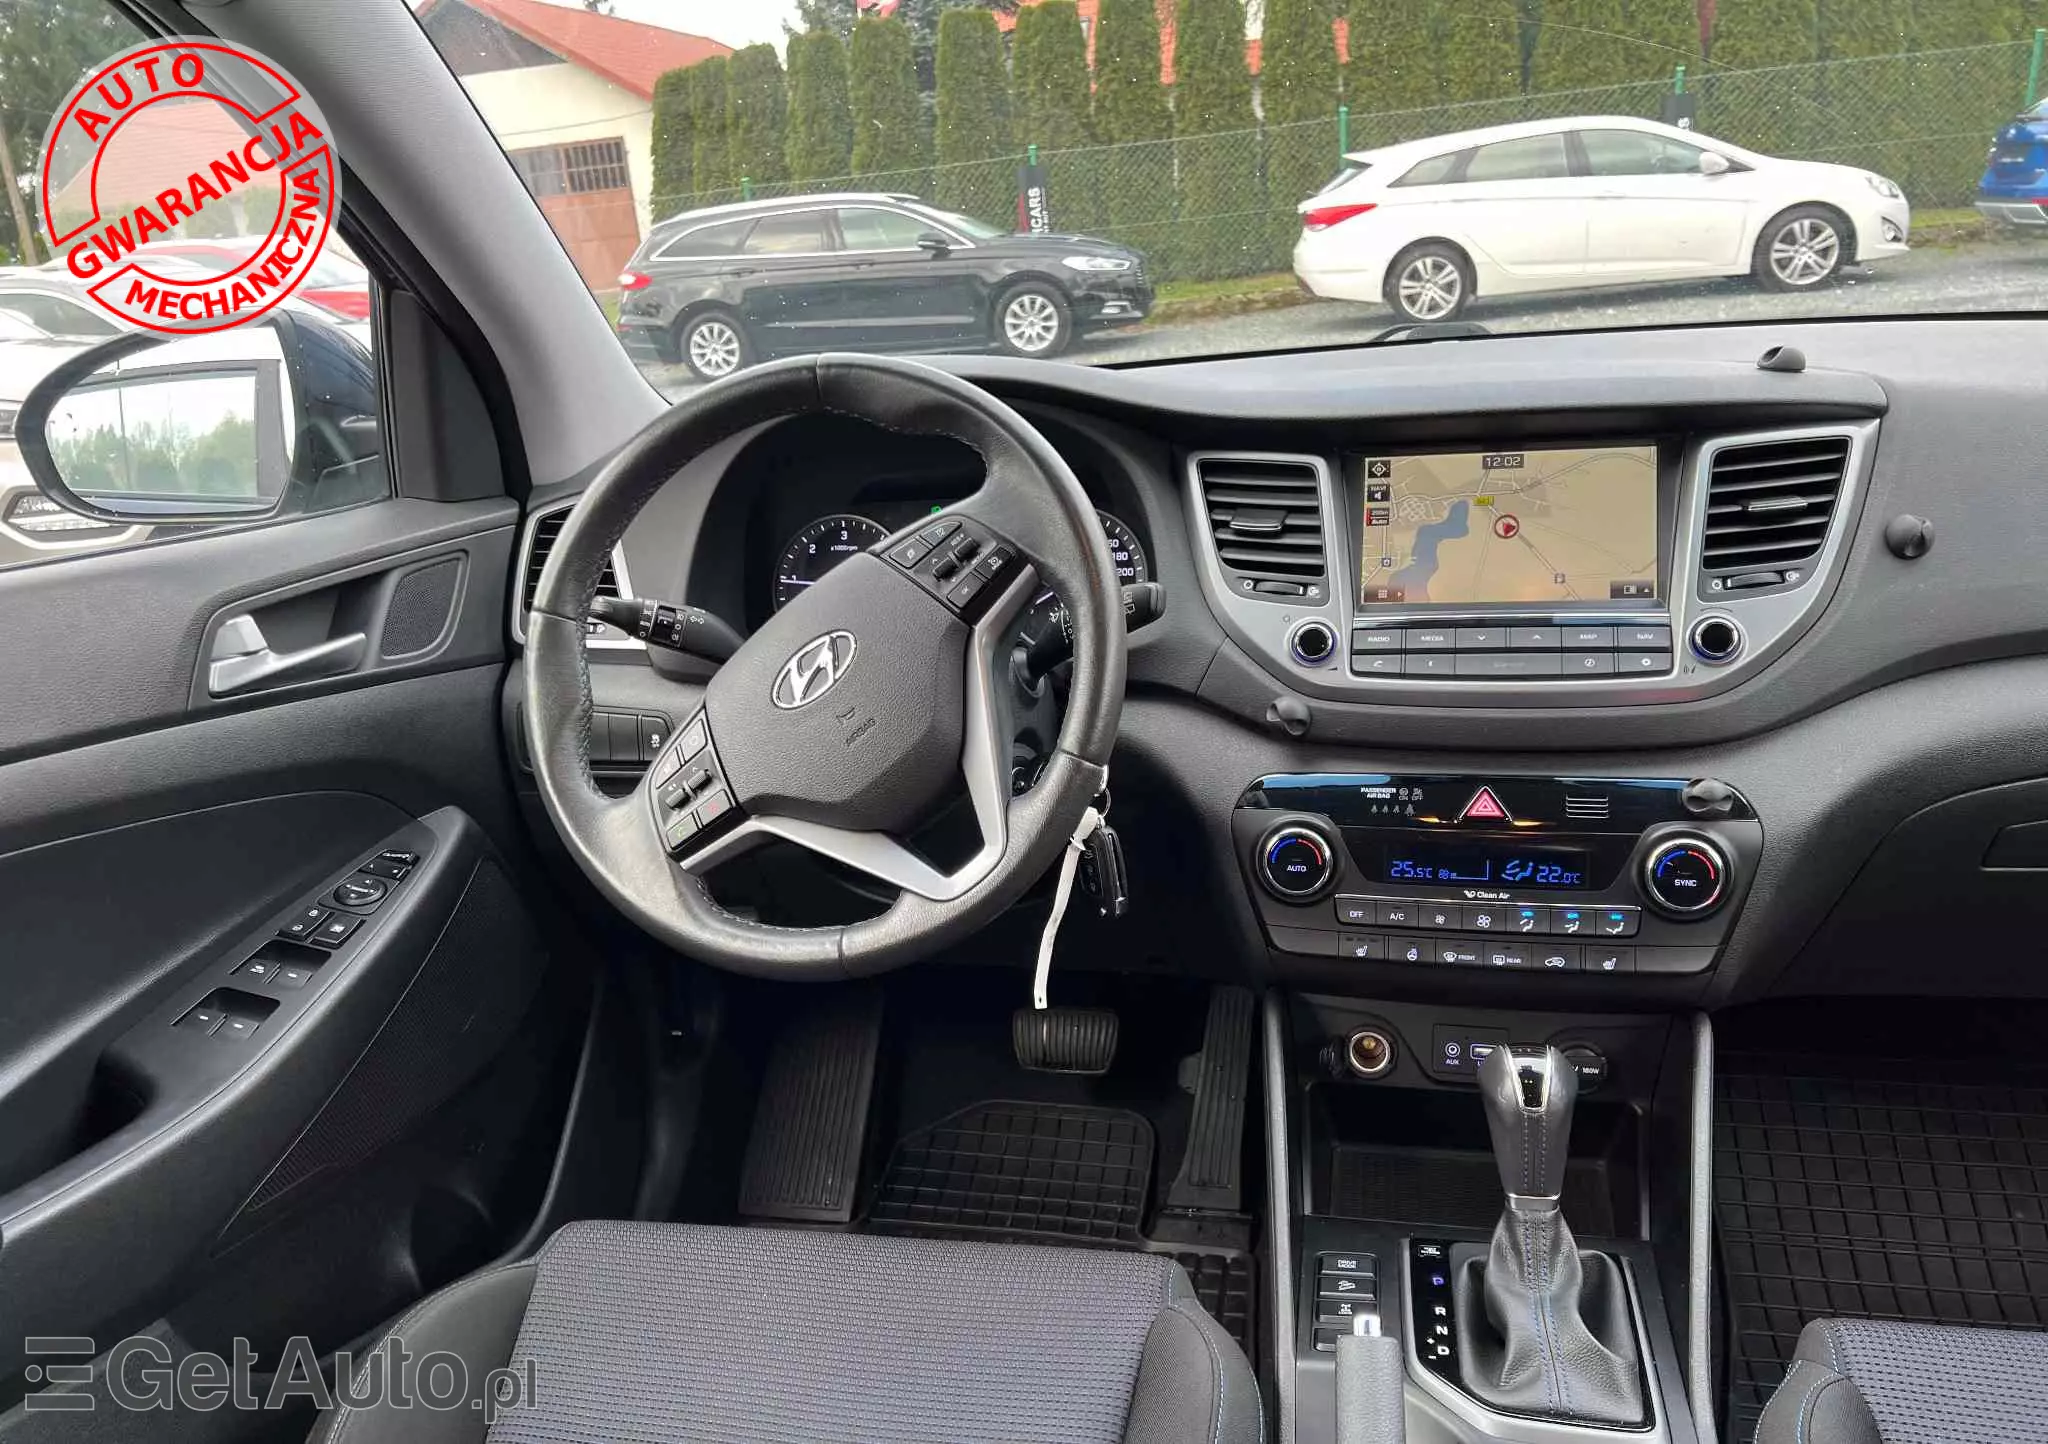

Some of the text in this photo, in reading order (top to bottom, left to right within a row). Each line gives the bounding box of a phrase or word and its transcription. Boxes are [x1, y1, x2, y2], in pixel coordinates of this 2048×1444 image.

[840, 531, 848, 540] 3
[809, 544, 816, 554] 2
[1367, 635, 1390, 643] RADIO
[1674, 879, 1697, 887] SYNC
[1476, 890, 1511, 900] Clean Air
[1349, 910, 1364, 918] OFF
[1389, 911, 1405, 921] A/C
[1435, 1306, 1446, 1316] R
[1436, 1325, 1448, 1335] N
[1437, 1345, 1450, 1355] D
